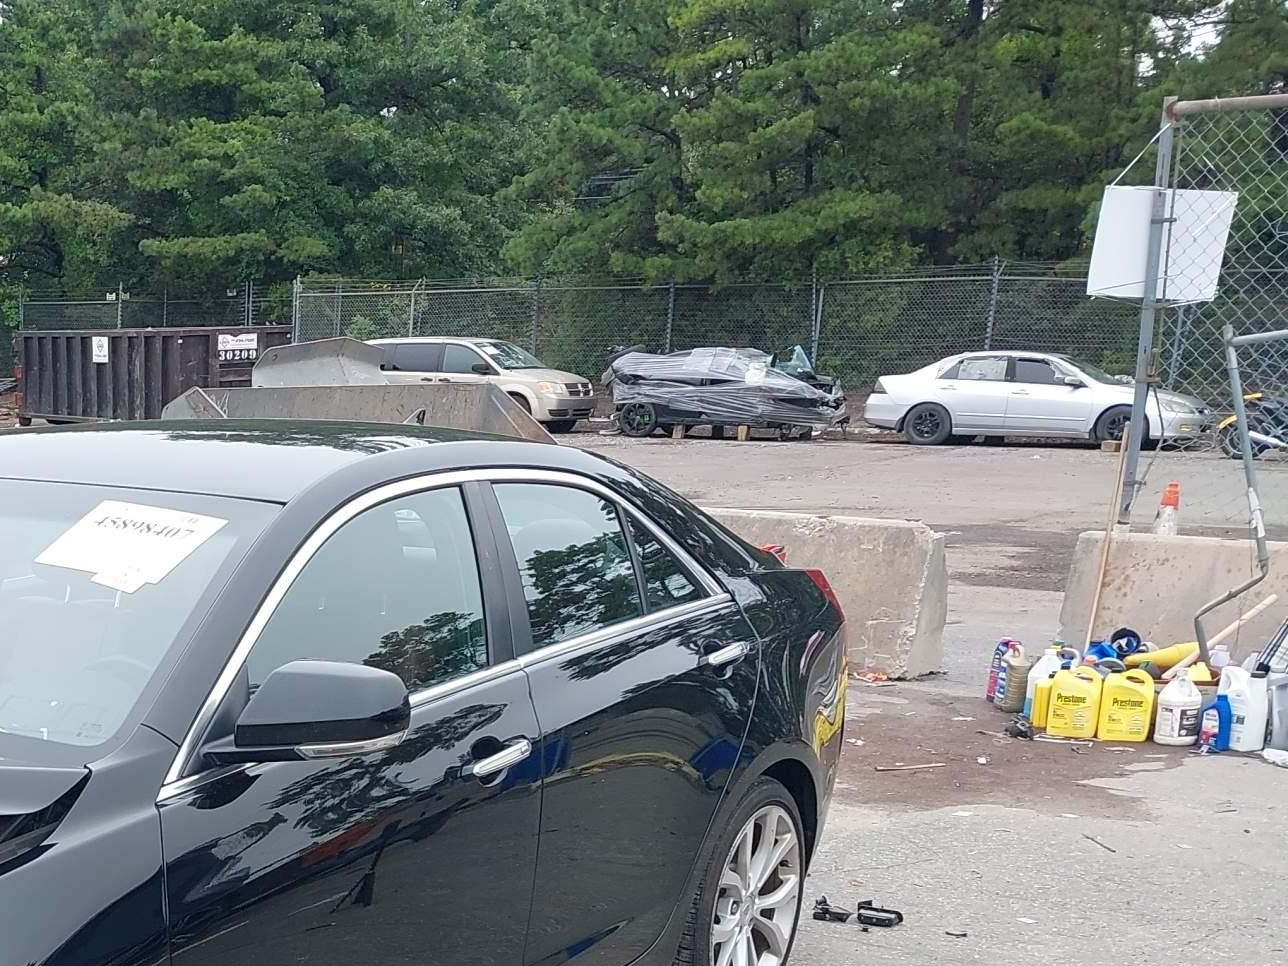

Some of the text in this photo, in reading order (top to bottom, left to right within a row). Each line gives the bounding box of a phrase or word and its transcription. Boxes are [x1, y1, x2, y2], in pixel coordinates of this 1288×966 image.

[218, 349, 257, 361] 30209
[1056, 693, 1087, 703] Prestone
[1112, 697, 1144, 708] Prestone
